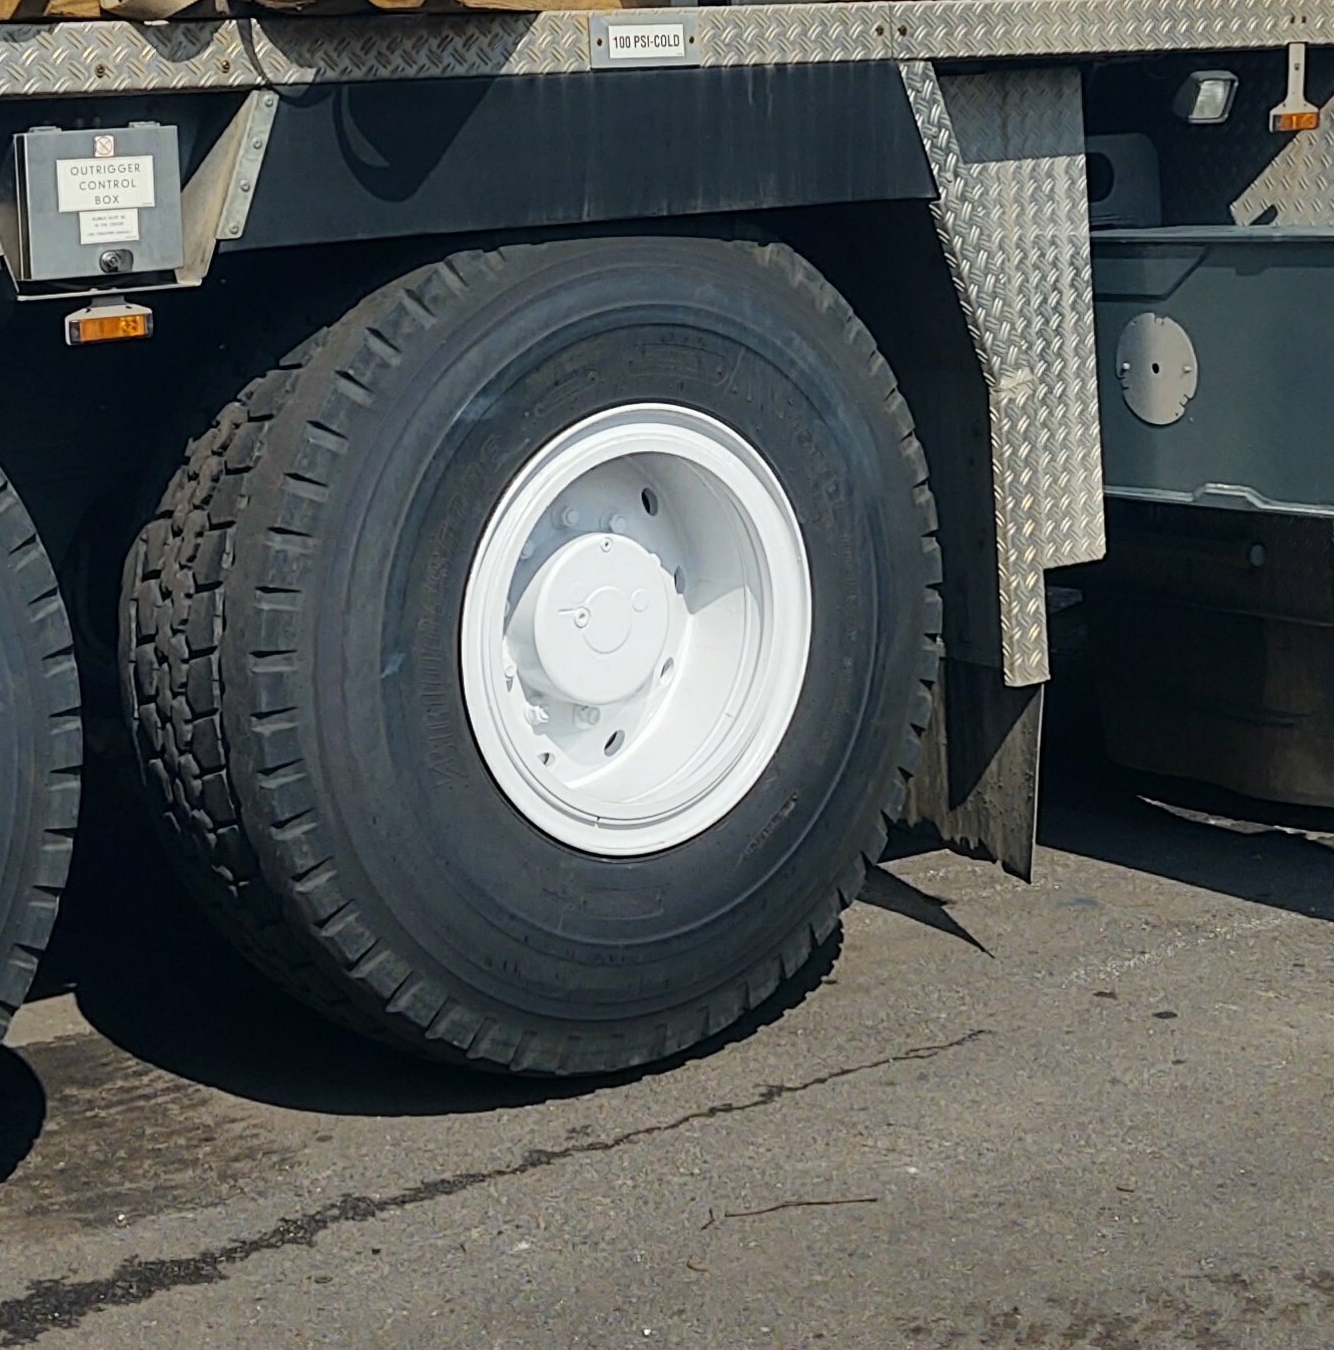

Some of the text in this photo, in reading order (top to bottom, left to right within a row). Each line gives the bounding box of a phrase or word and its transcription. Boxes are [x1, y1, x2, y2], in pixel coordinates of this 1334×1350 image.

[613, 34, 681, 49] 100 PSI-COLD
[69, 163, 141, 177] OUTRIGGER
[78, 178, 137, 191] CONTROL
[94, 195, 120, 206] BOX
